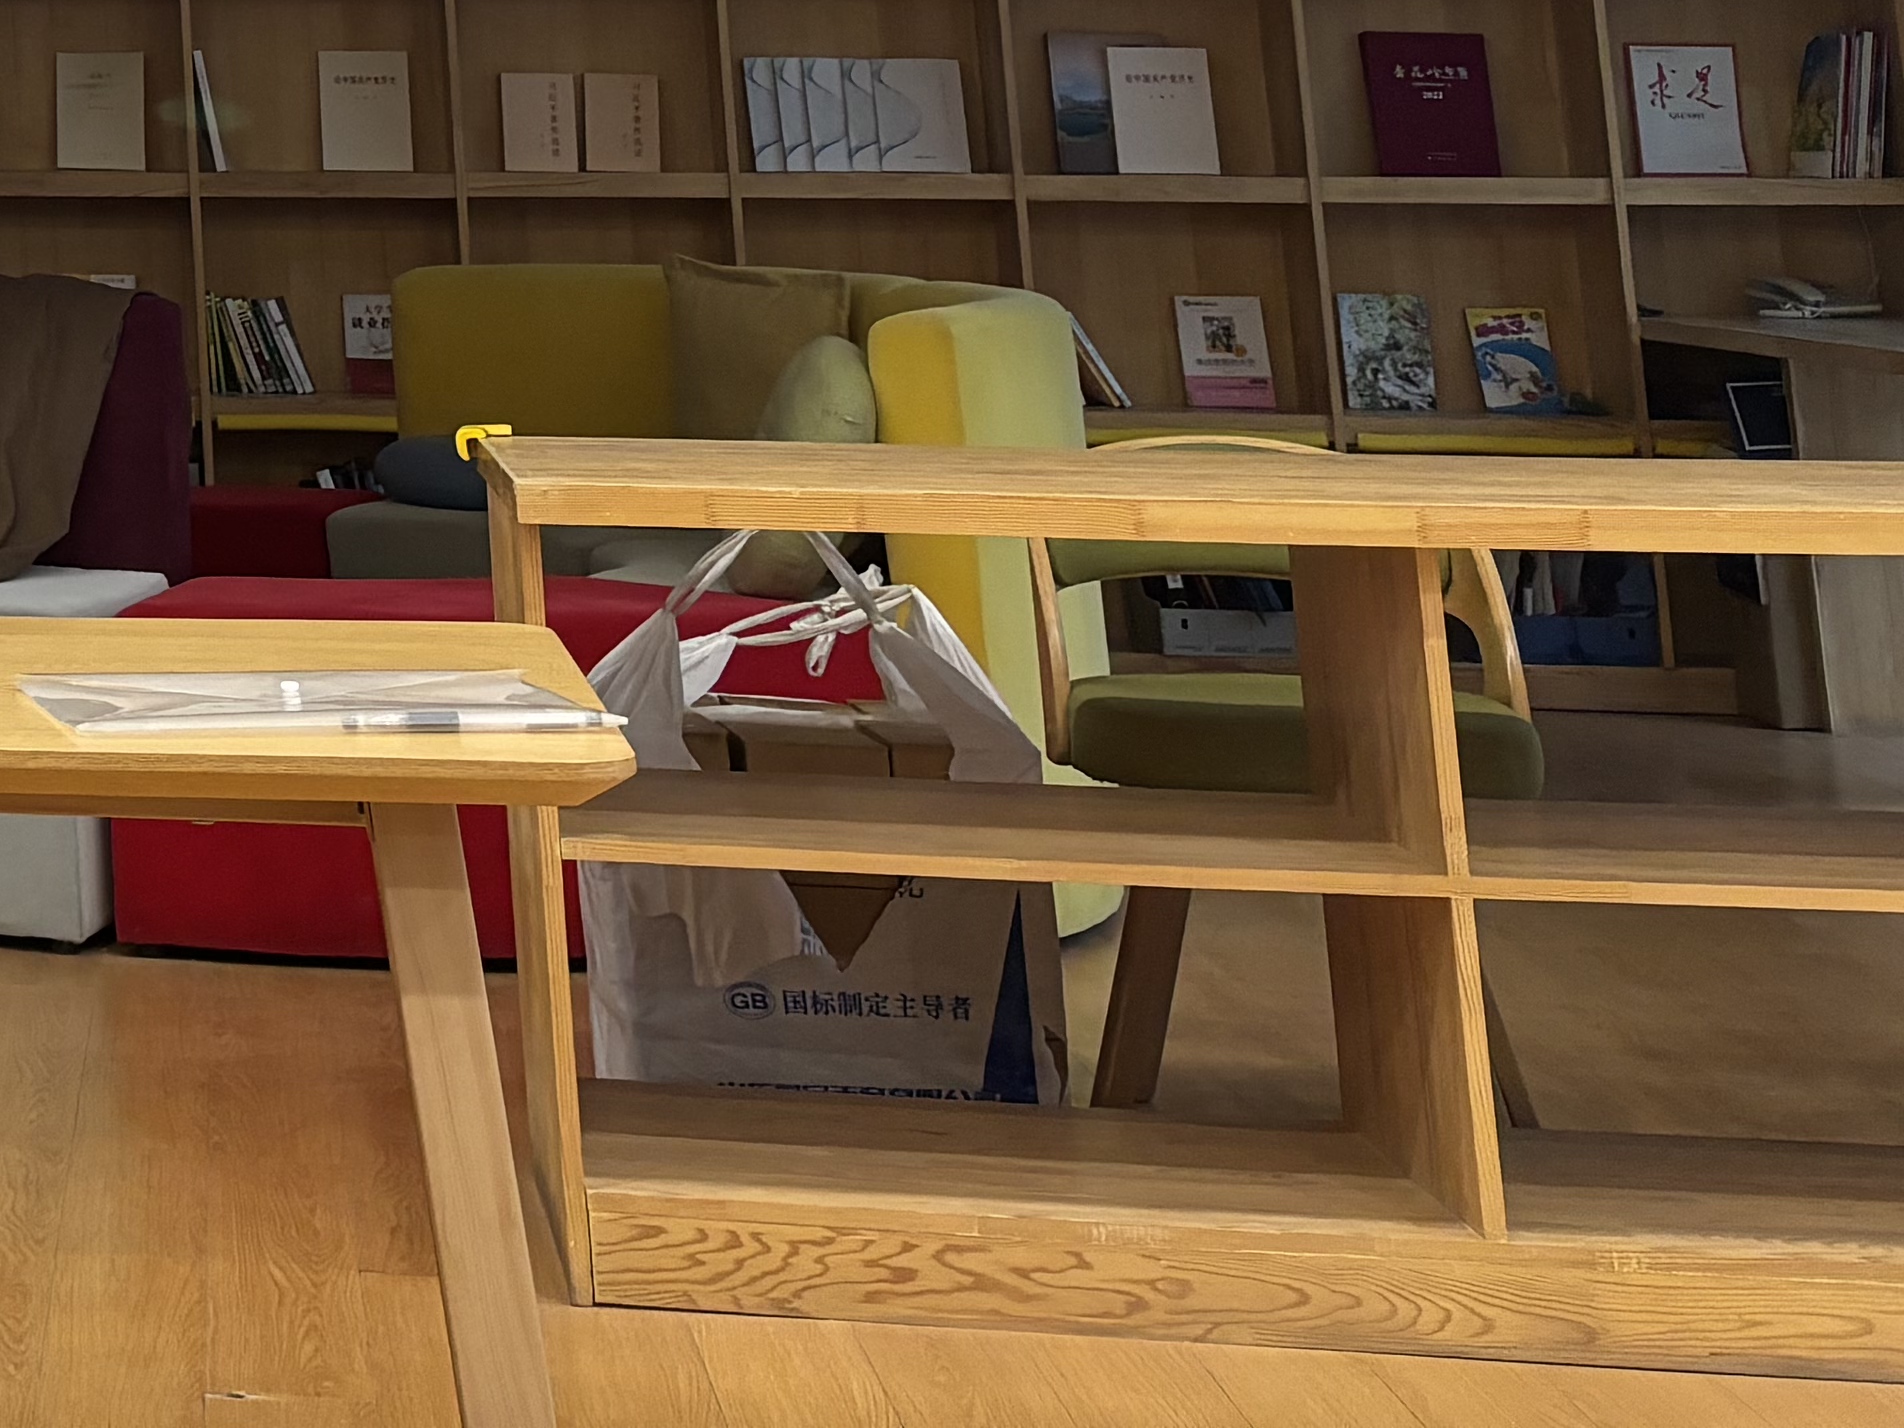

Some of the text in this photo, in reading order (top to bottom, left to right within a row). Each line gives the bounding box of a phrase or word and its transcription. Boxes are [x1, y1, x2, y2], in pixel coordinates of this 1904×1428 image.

[1648, 62, 1724, 109] 求是
[782, 989, 972, 1021] 国标制定主导者
